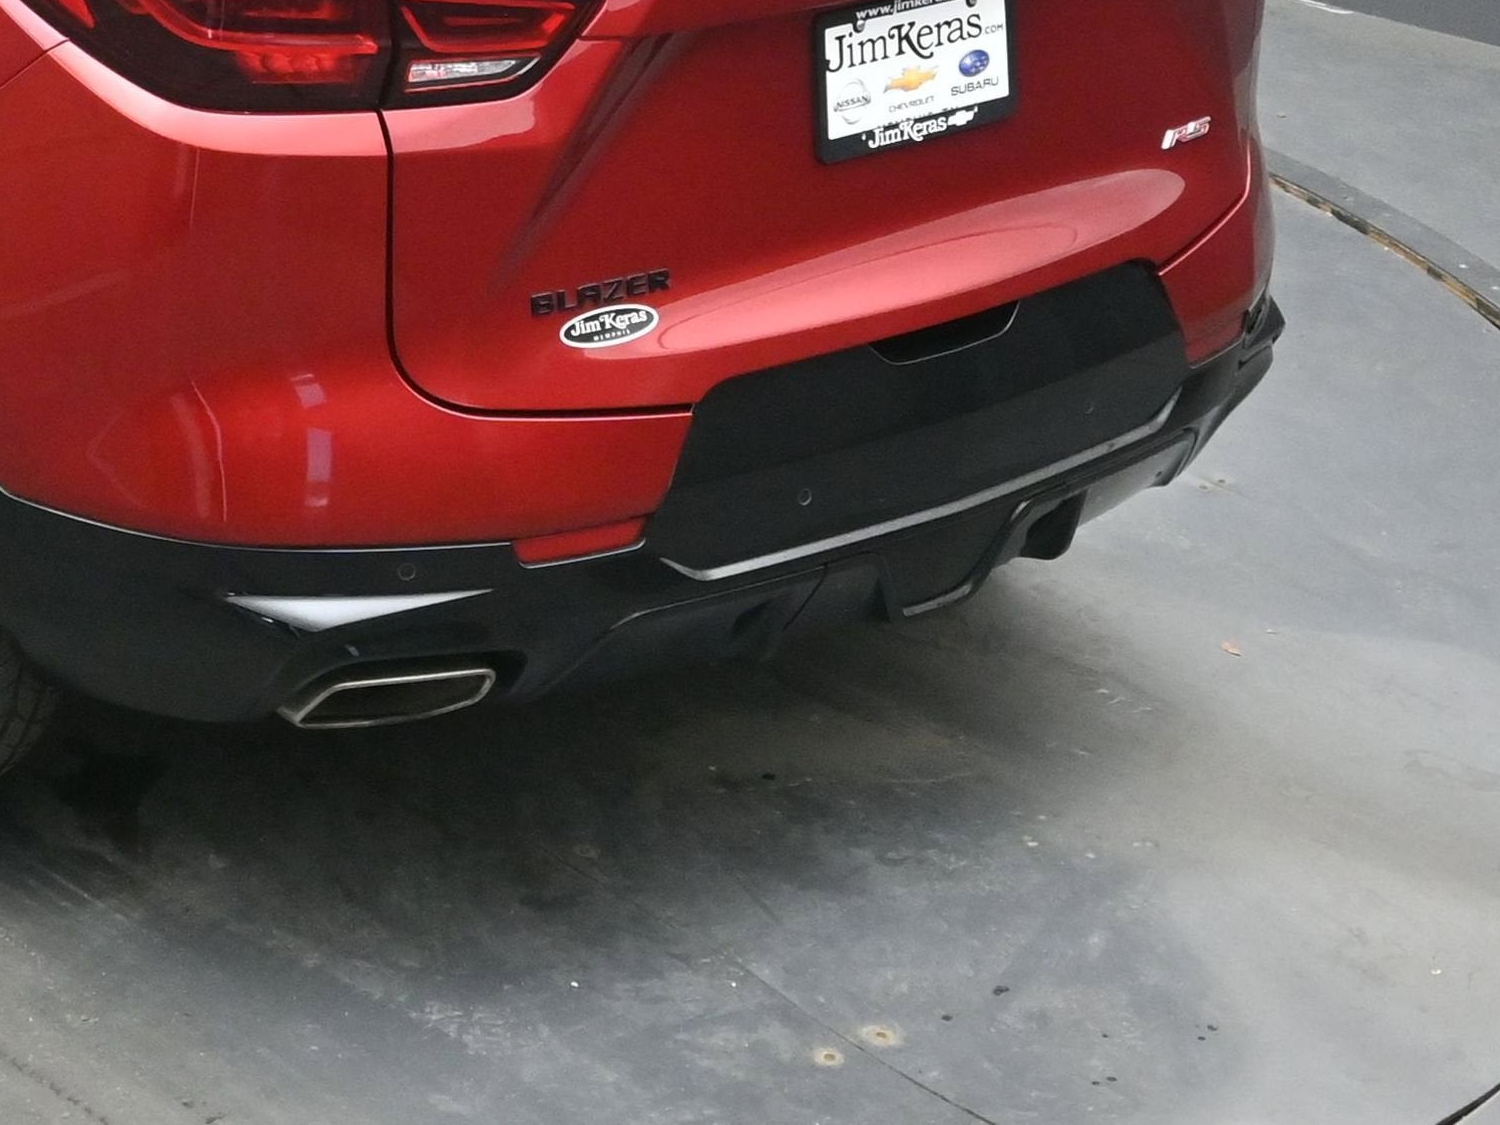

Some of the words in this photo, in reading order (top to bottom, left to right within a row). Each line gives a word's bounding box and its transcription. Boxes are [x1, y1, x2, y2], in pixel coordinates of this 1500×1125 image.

[950, 76, 1000, 97] SUBARU
[888, 95, 935, 113] CHEVROLET
[530, 267, 672, 317] BLAZER
